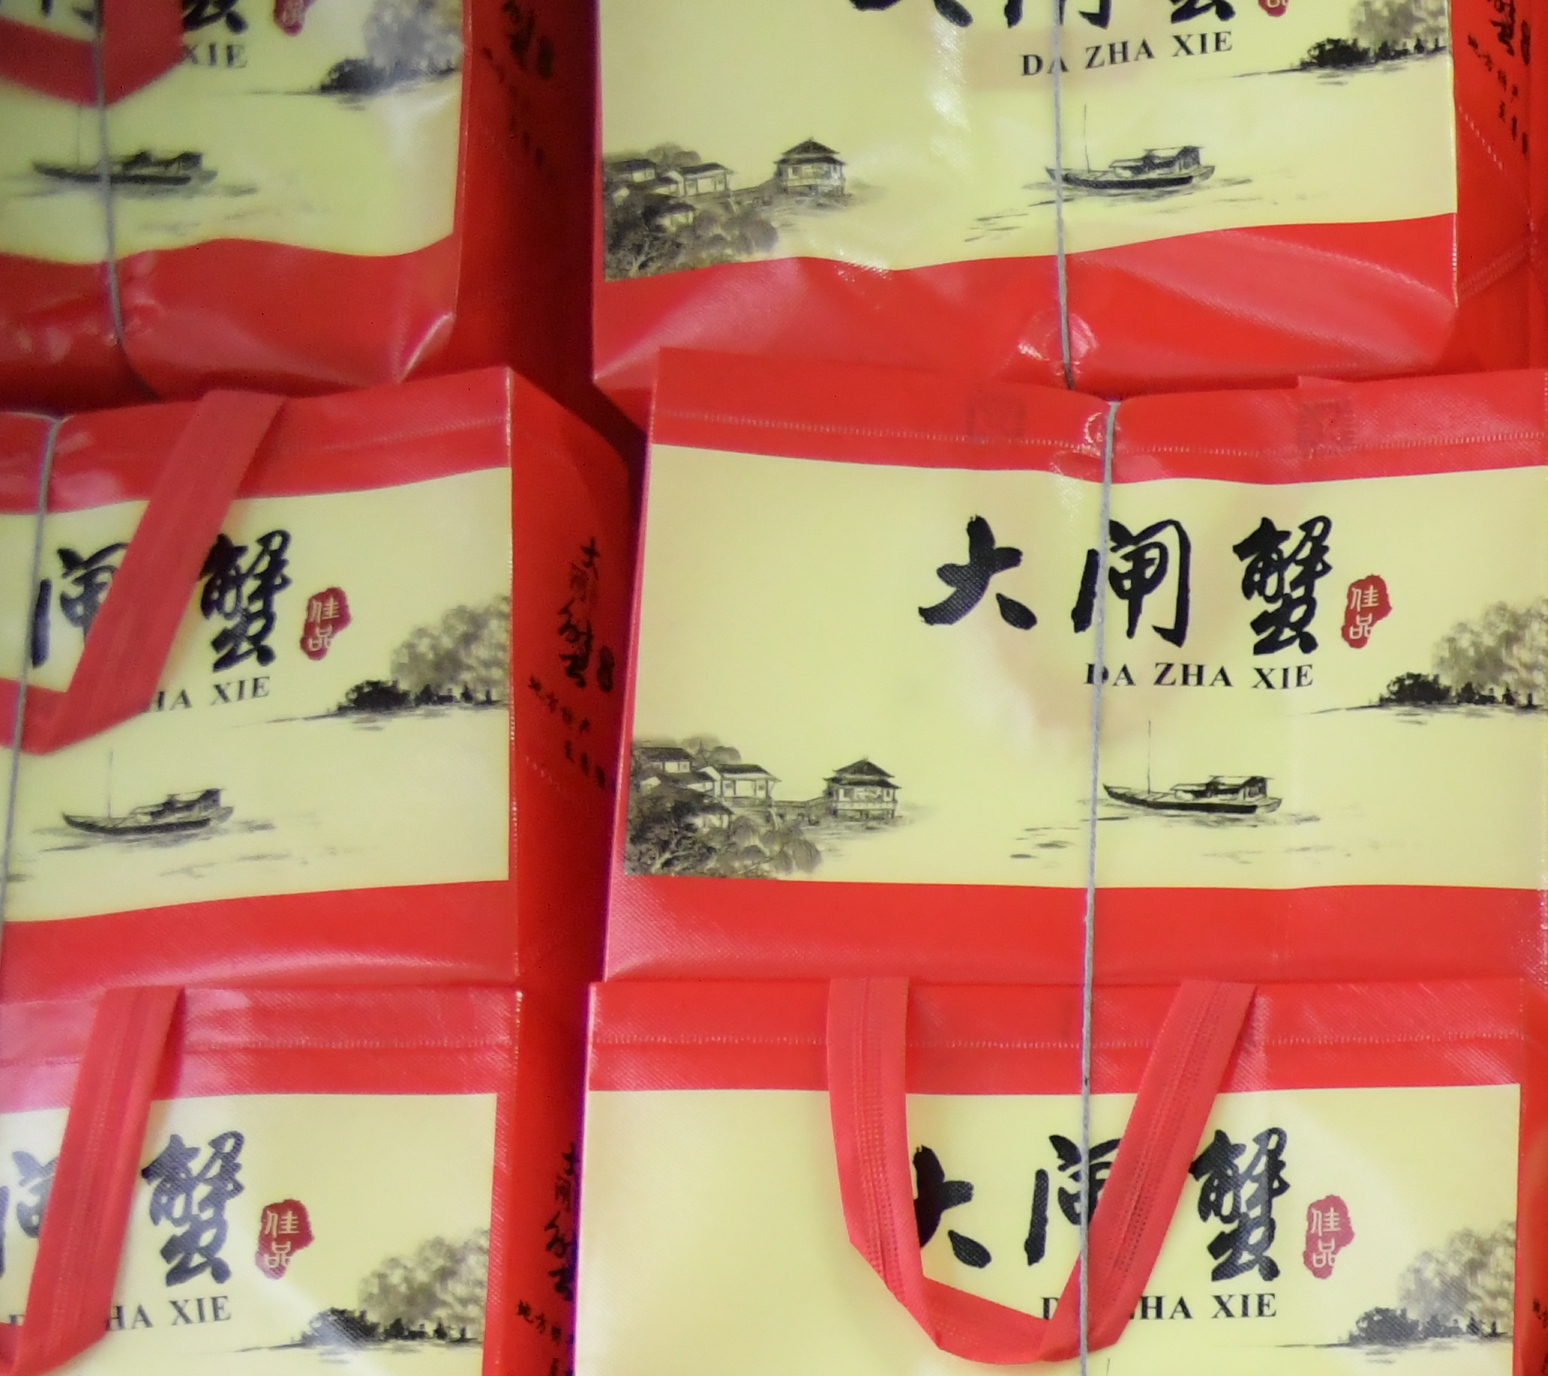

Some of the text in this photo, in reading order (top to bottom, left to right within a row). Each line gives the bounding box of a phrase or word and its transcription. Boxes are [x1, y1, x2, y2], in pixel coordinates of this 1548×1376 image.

[1021, 30, 1234, 77] DA ZHA XIE
[918, 513, 1334, 655] 大闸蟹
[305, 594, 343, 655] 佳品
[1349, 584, 1383, 642] 佳品
[142, 675, 271, 713] HA XIE
[1084, 660, 1315, 691] DA ZHA XIE
[1310, 1206, 1342, 1269] 佳品
[105, 1294, 234, 1330] HA XIE
[1130, 1294, 1278, 1321] HA XIE
